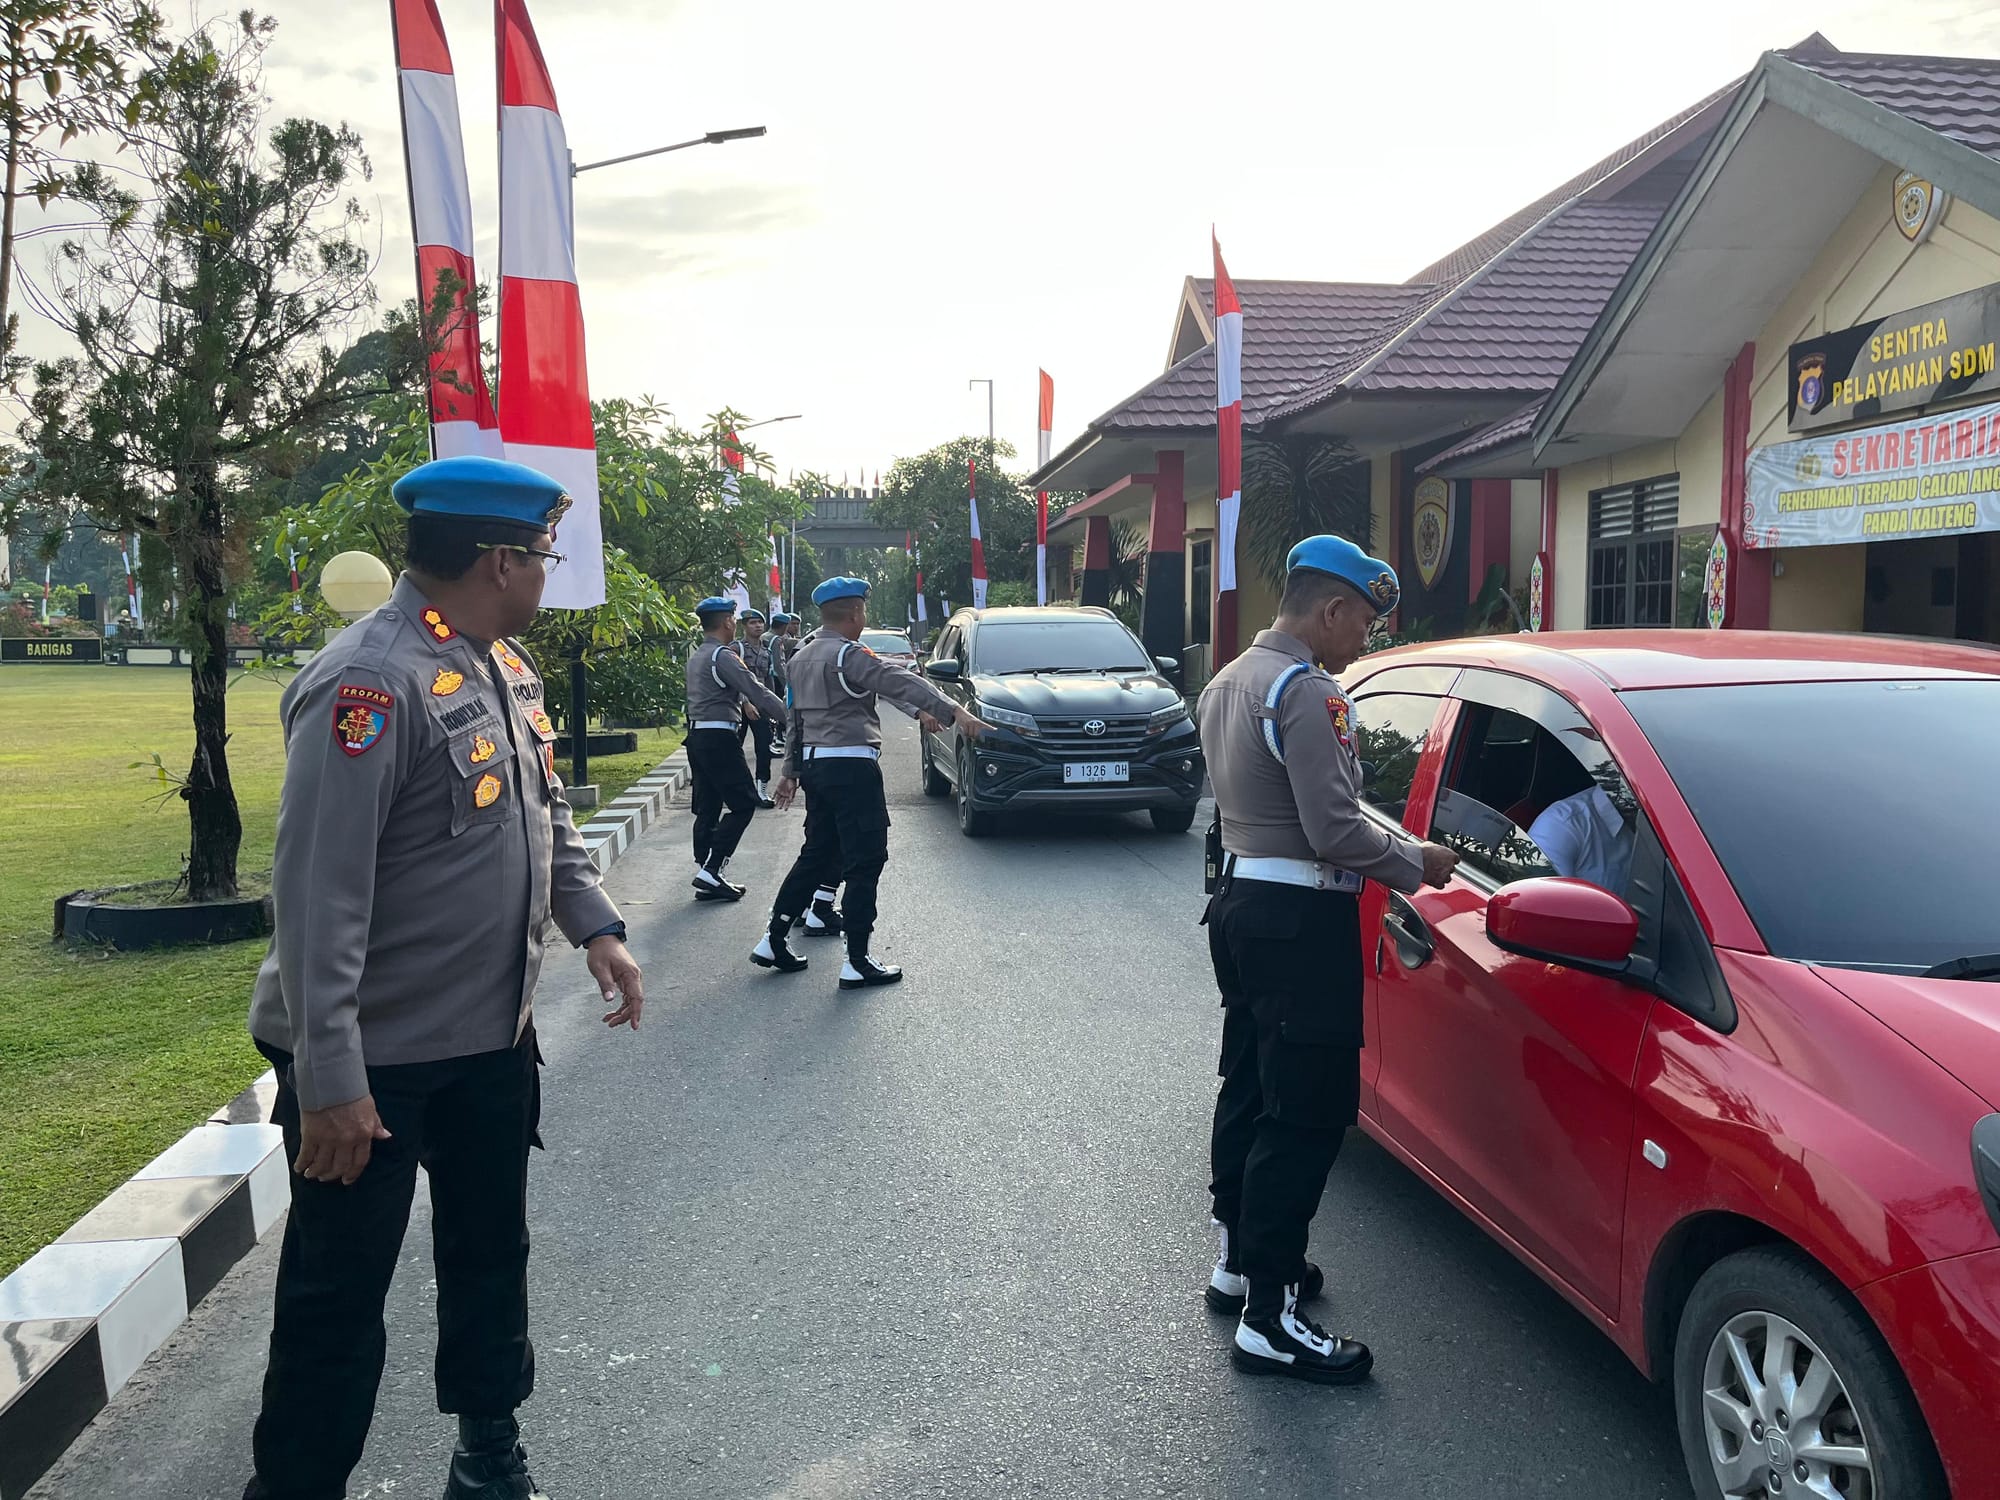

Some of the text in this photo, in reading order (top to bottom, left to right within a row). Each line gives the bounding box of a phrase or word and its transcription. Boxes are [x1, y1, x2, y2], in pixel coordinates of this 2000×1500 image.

[1870, 317, 1948, 364] SENTRA
[1832, 342, 1996, 408] PELAYANAN SDM
[1778, 484, 1854, 513] PENERIMAAN
[1856, 476, 1919, 506] TERPADU
[1919, 469, 1970, 500] CALON
[1862, 501, 1977, 536] PANDA KALTENG
[26, 643, 73, 656] BARIGAS
[343, 687, 389, 704] PROPAM
[1065, 766, 1072, 778] B
[1081, 764, 1106, 777] 1326
